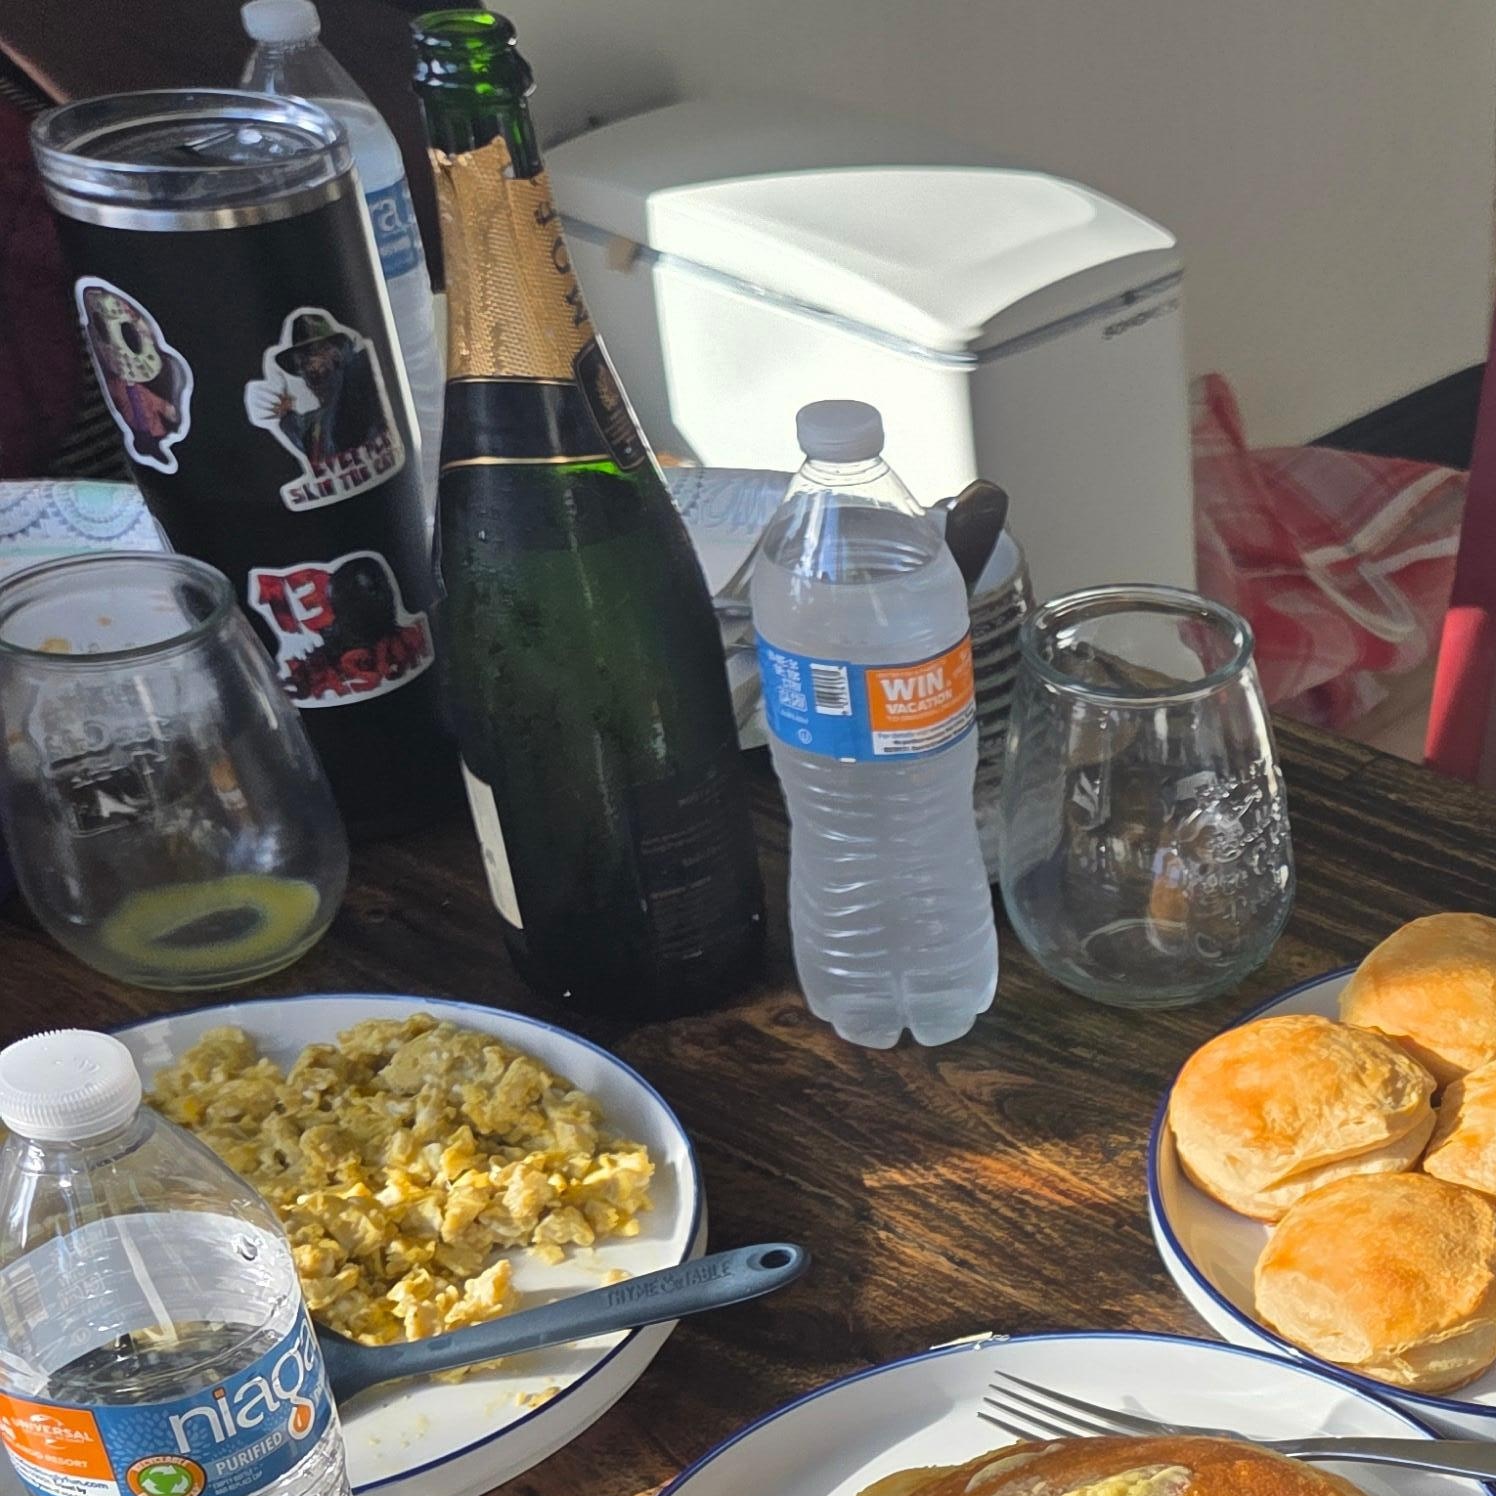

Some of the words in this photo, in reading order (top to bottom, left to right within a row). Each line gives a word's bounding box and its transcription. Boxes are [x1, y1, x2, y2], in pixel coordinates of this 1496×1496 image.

[880, 666, 945, 701] WIN
[885, 688, 953, 715] VACATION
[607, 1278, 661, 1307] THYME
[685, 1259, 733, 1286] TABLE
[169, 1318, 318, 1454] niaga
[216, 1431, 282, 1475] PURIFIED
